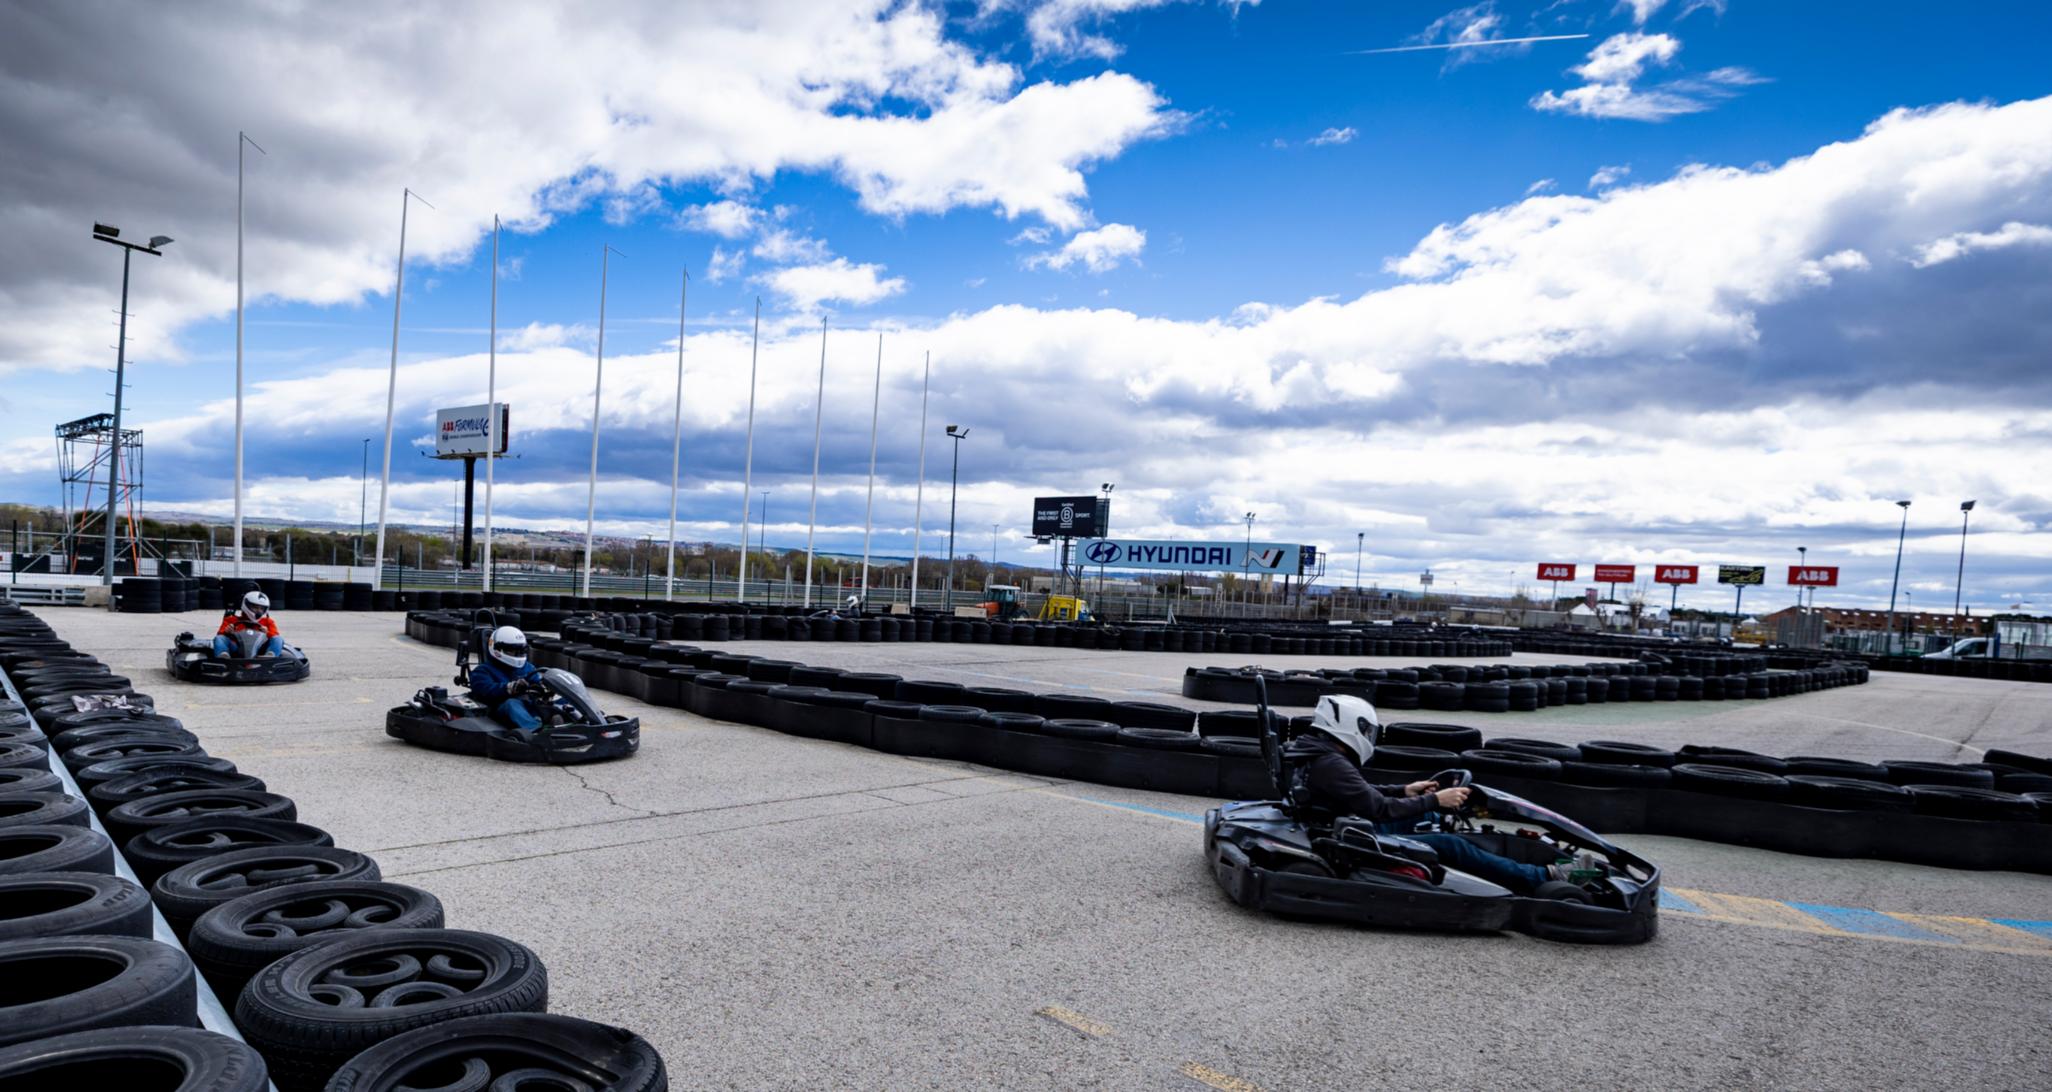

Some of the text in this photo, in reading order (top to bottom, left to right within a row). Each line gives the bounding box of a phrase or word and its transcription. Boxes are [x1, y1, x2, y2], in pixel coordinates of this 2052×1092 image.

[1128, 545, 1231, 566] HYUNDAI
[1543, 567, 1569, 577] ABB
[1662, 569, 1691, 579] ABB
[1796, 570, 1830, 581] ABB
